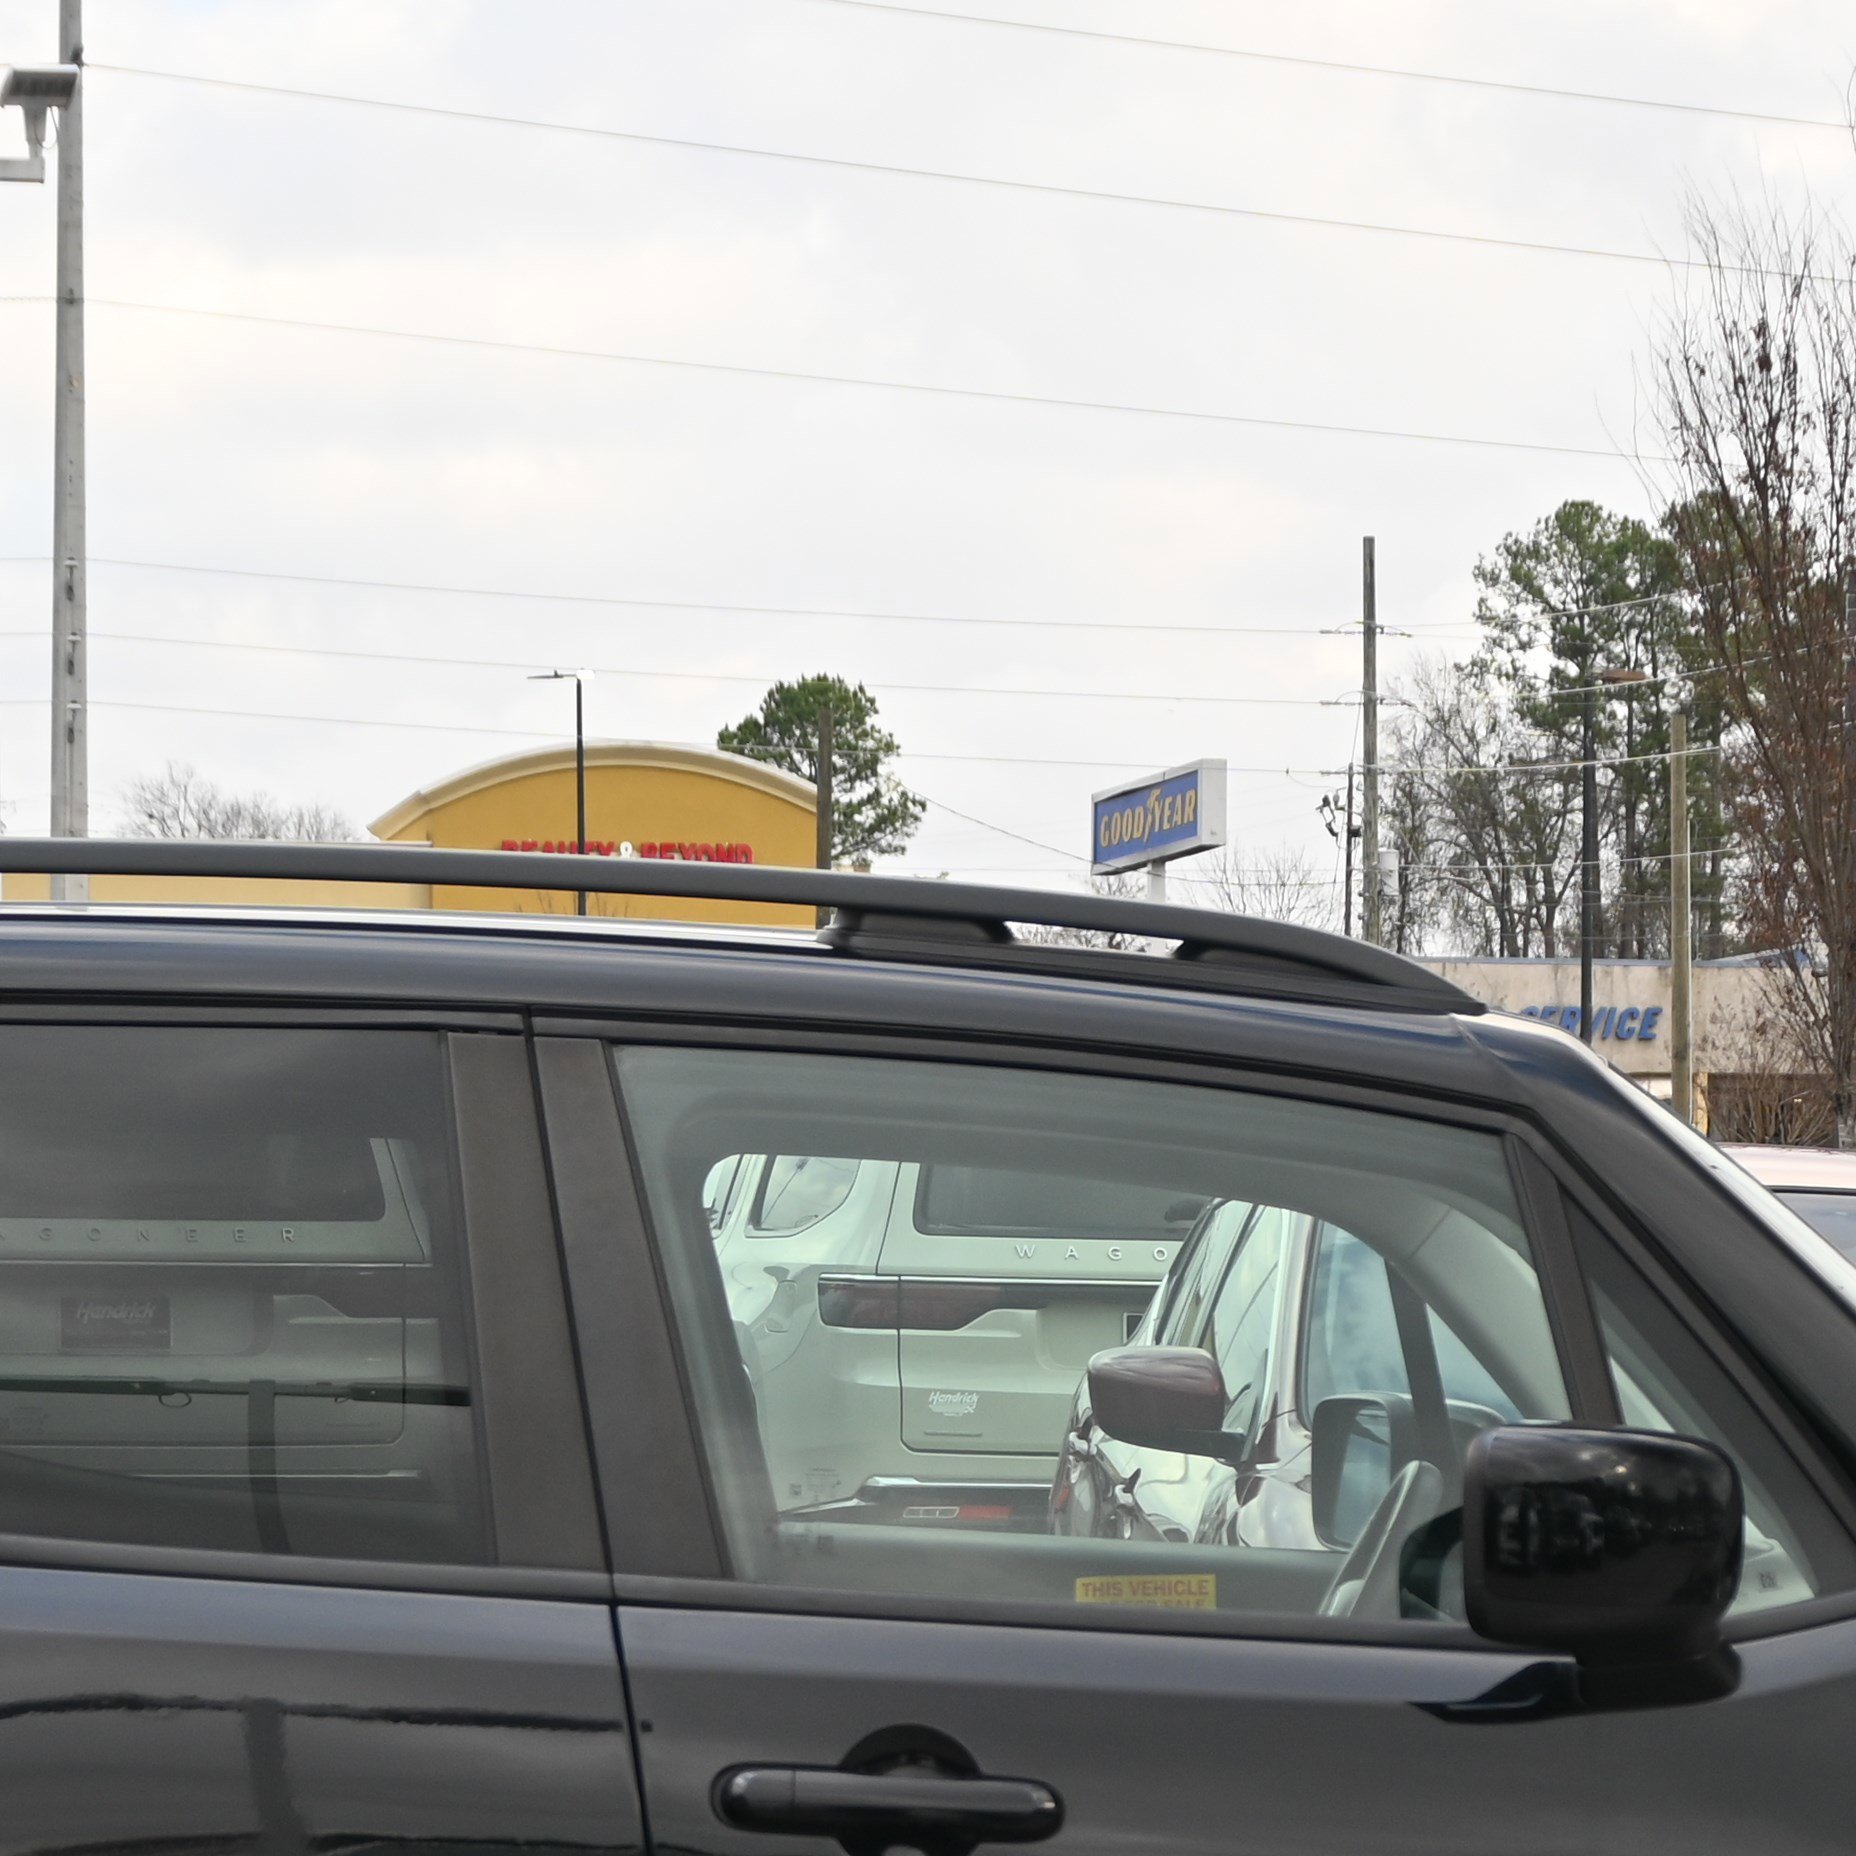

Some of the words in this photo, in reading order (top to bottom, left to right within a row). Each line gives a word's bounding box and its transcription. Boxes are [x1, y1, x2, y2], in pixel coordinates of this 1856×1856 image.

[1100, 789, 1197, 847] GOODYEAR
[1082, 1581, 1124, 1597] THIS
[1128, 1579, 1210, 1597] VEHICLE
